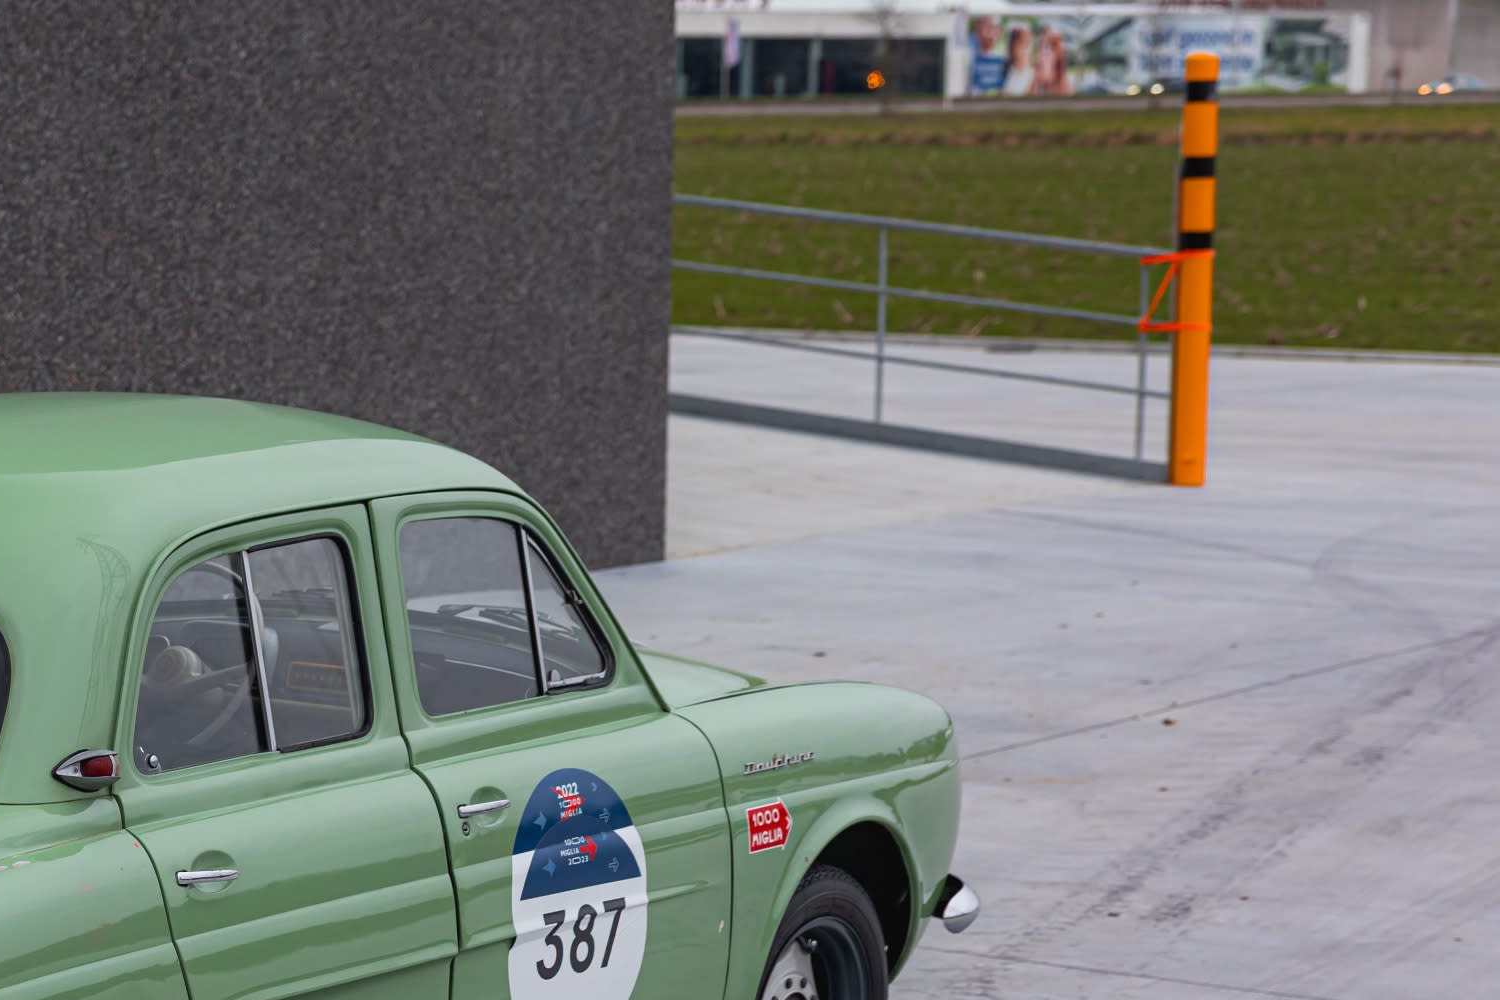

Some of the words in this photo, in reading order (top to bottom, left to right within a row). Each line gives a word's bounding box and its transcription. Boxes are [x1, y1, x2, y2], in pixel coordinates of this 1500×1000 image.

[556, 782, 579, 799] 2022
[558, 797, 581, 808] 1000
[560, 808, 583, 819] MIGLIA
[752, 808, 780, 827] 1000
[564, 836, 585, 846] 1000
[752, 827, 783, 848] MIGLIA
[560, 847, 580, 857] MIGLIA
[568, 855, 589, 866] 2023
[536, 897, 626, 980] 387
